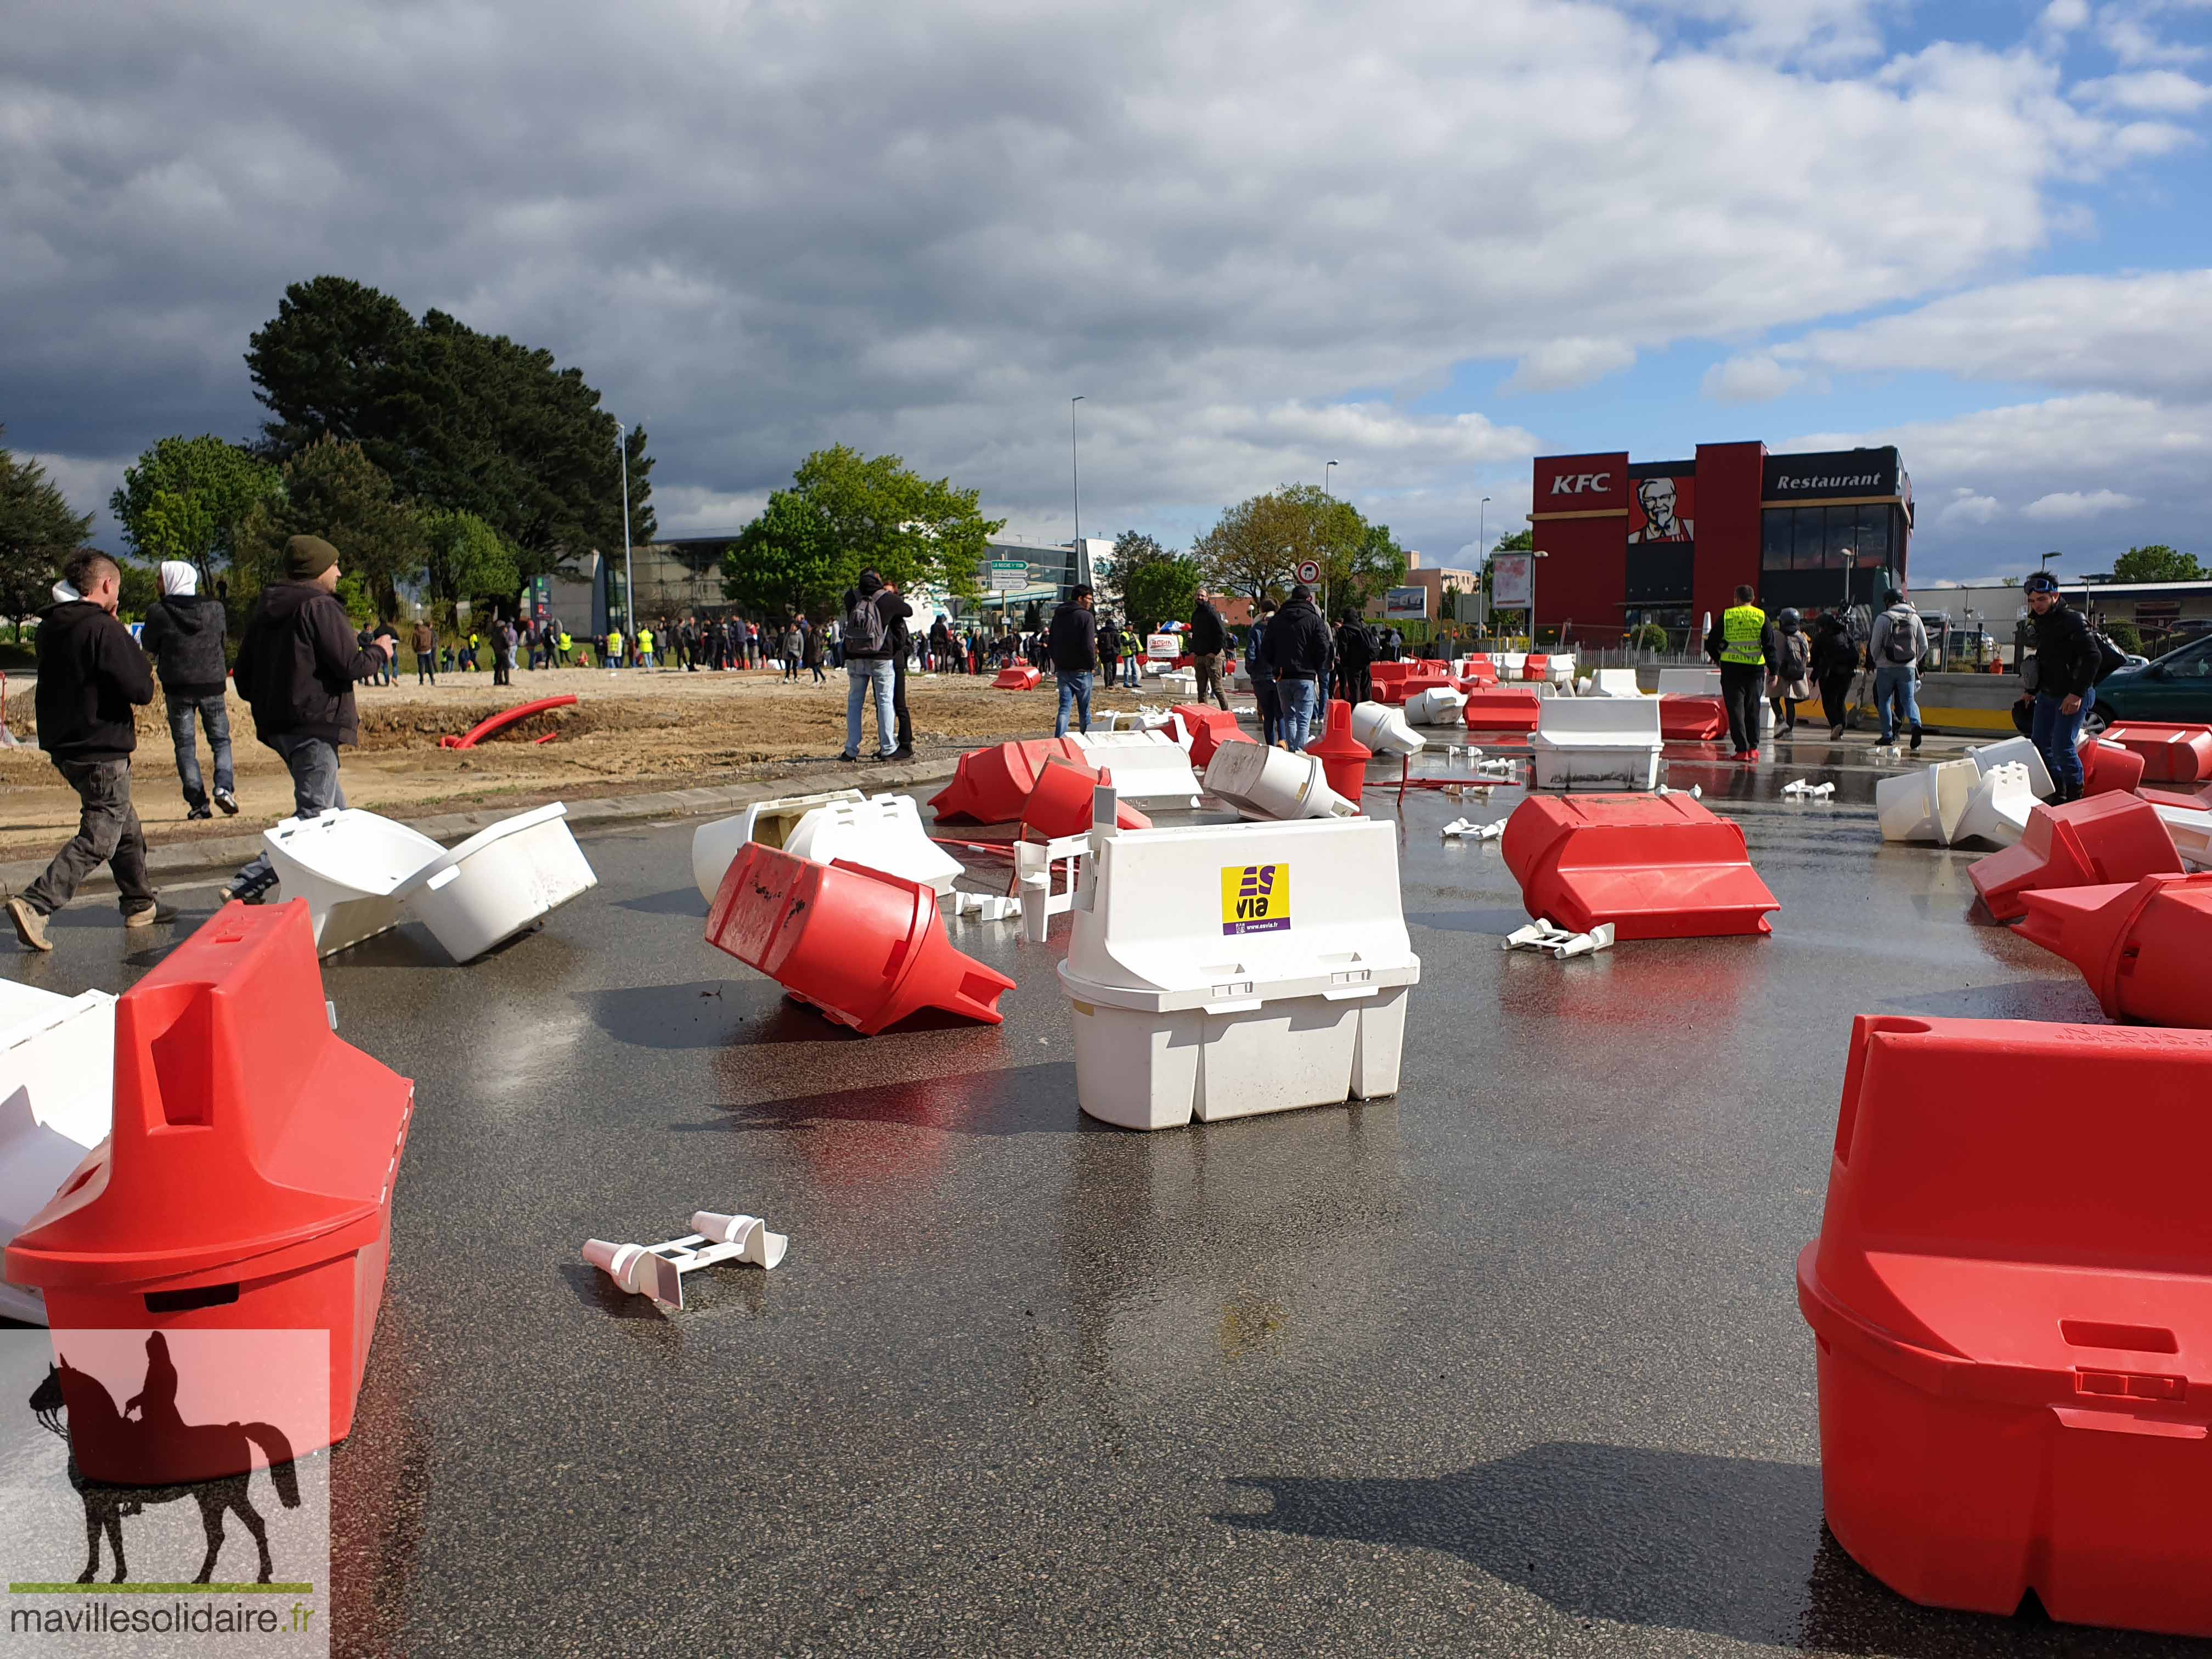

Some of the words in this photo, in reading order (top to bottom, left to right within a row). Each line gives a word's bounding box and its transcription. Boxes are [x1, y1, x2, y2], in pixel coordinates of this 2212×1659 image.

[1550, 473, 1610, 494] KFC
[1777, 472, 1882, 489] Restaurant
[1246, 922, 1278, 930] www.esvia.fr
